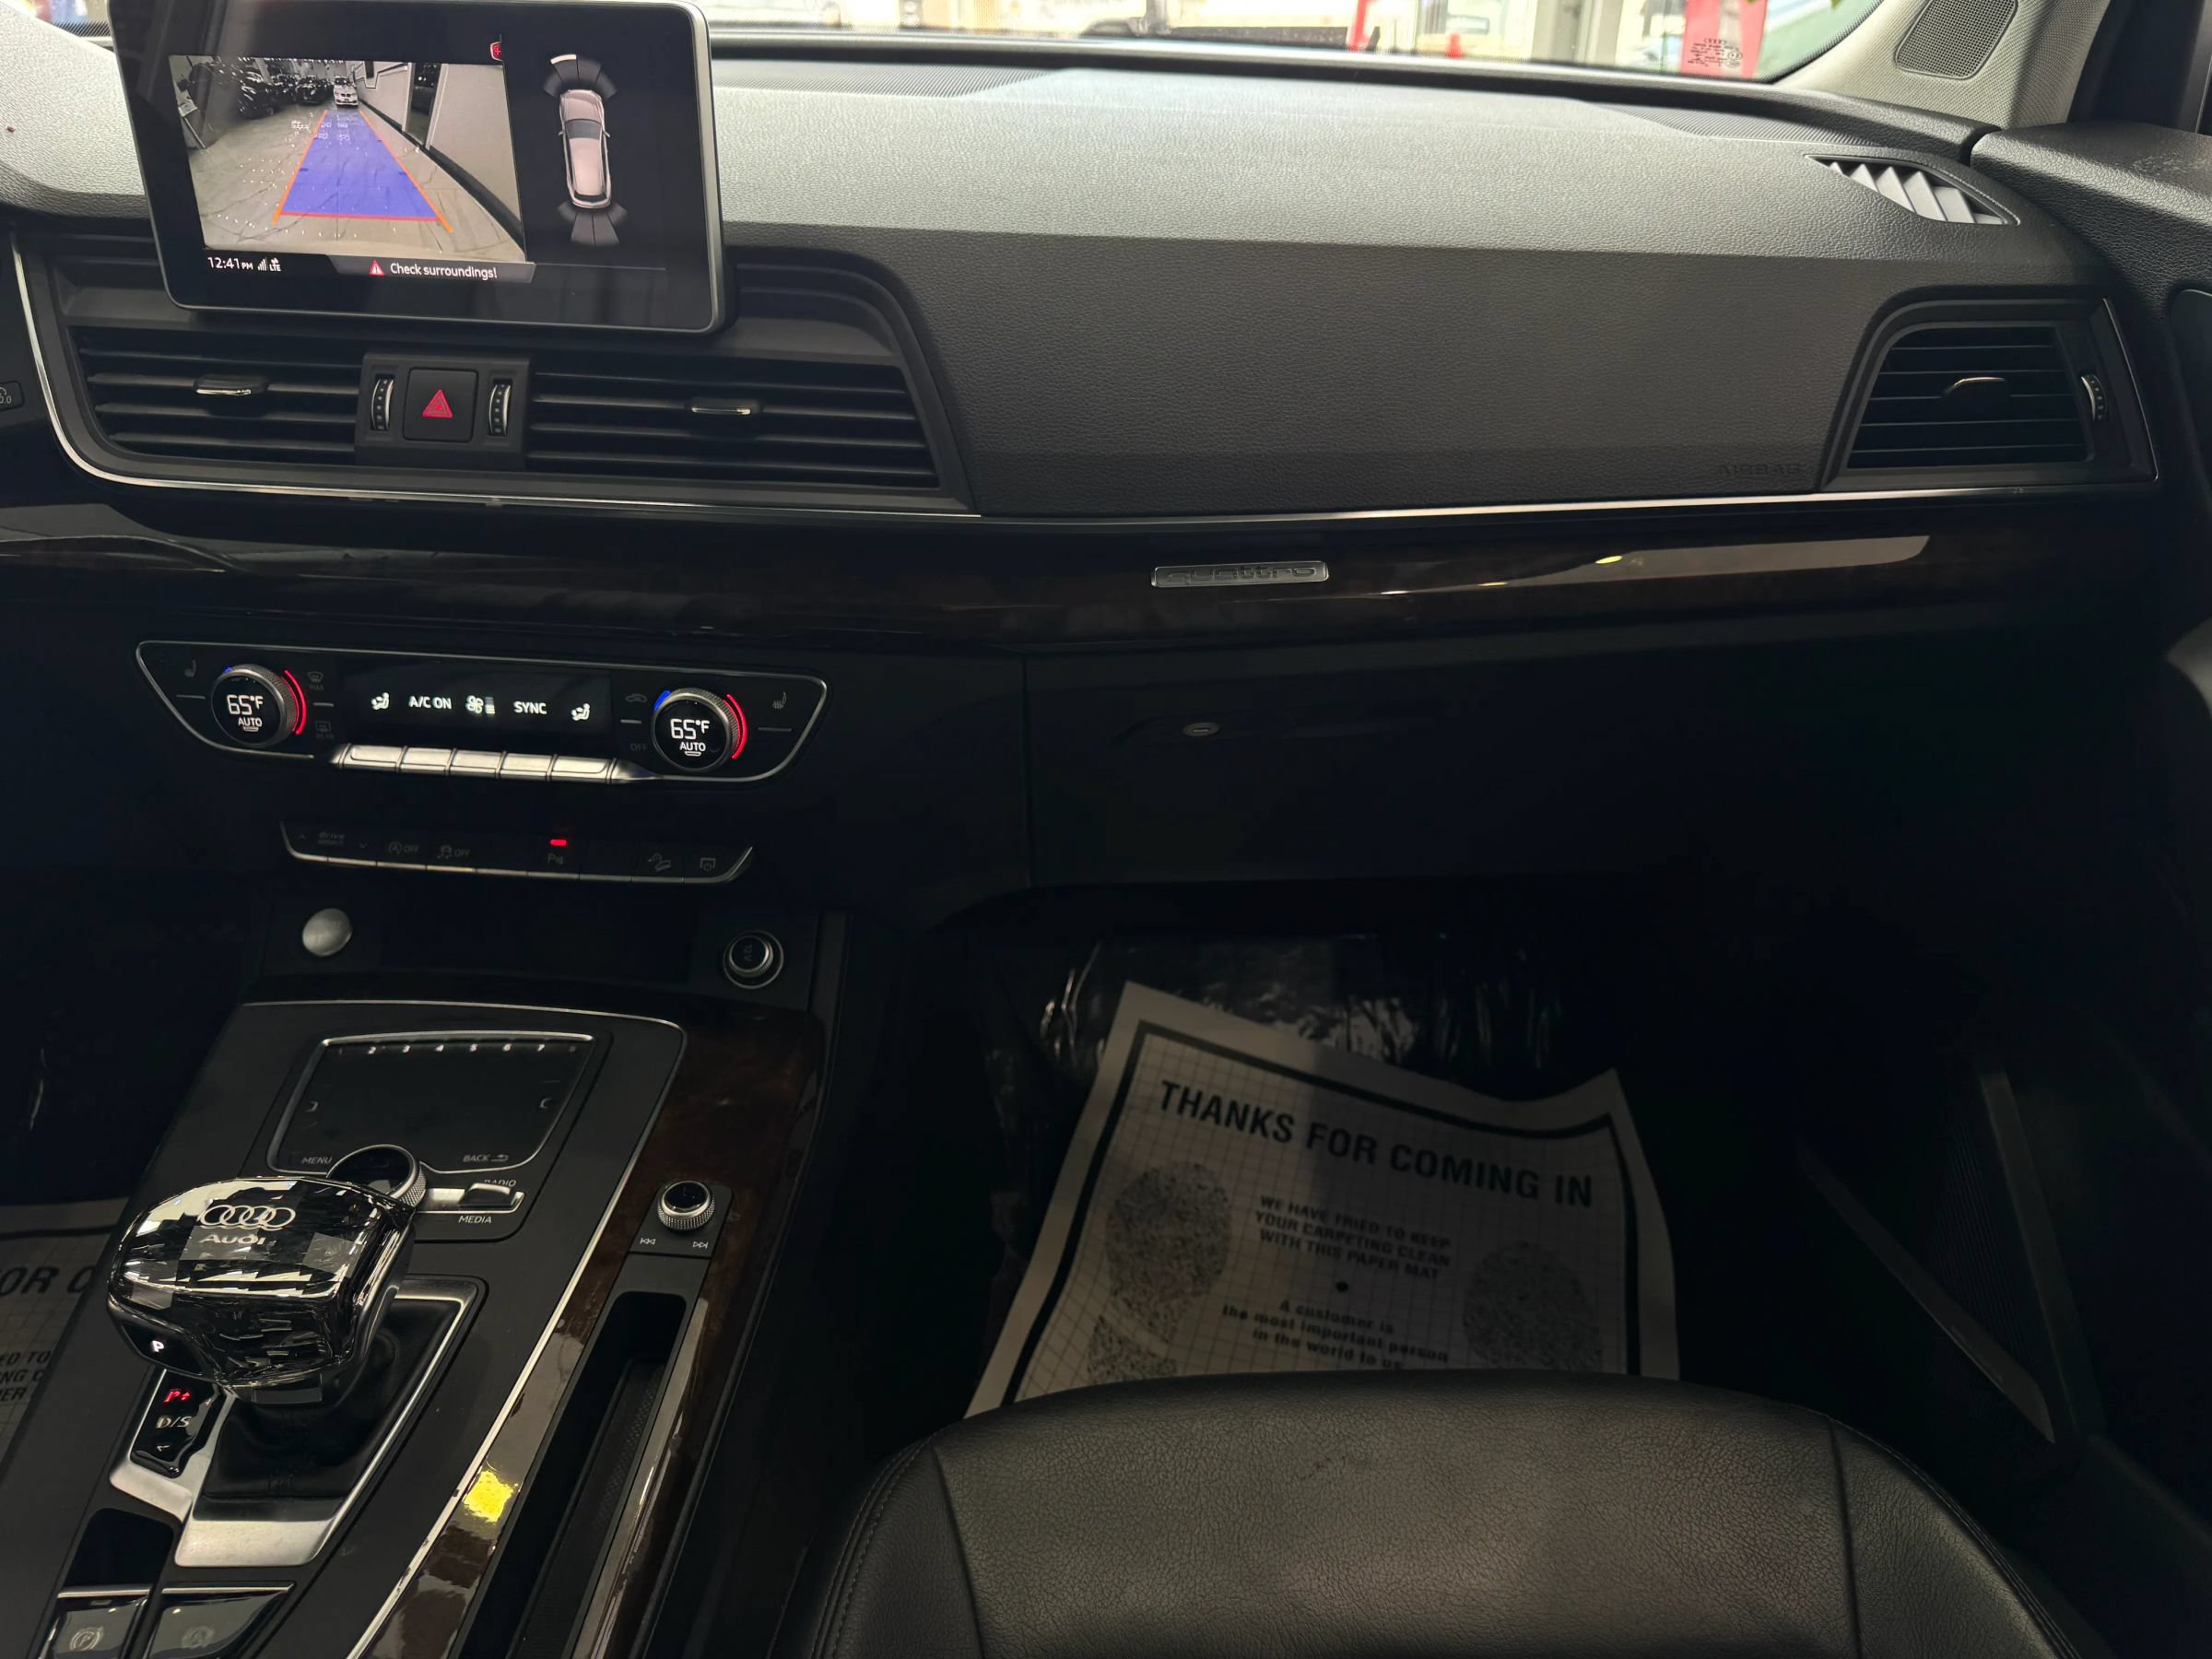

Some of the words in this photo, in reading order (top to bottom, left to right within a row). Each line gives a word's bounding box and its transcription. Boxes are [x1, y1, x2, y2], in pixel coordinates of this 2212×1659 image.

[390, 263, 421, 276] Check
[423, 265, 498, 280] surroundings!
[408, 695, 431, 709] A/C
[432, 696, 453, 710] ON
[512, 700, 547, 715] SYNC
[238, 717, 263, 727] AUTO
[679, 741, 707, 752] AUTO
[1161, 1080, 1295, 1143] THANKS
[1306, 1123, 1378, 1164] FOR
[1391, 1144, 1539, 1200] COMING
[1555, 1174, 1593, 1207] IN
[301, 1156, 333, 1165] MENU
[463, 1154, 489, 1163] BACK
[458, 1216, 492, 1225] MEDIA
[1260, 1195, 1281, 1211] WE
[1288, 1201, 1327, 1223] HAVE
[1335, 1213, 1380, 1233] TRIED
[1386, 1225, 1406, 1241] TO
[1410, 1232, 1451, 1248] KEEP
[1255, 1211, 1299, 1232] YOUR
[1302, 1225, 1393, 1254] CARPETING
[1397, 1245, 1450, 1267] CLEAN
[1260, 1230, 1301, 1250] WITH
[1307, 1240, 1342, 1260] THIS
[1347, 1250, 1400, 1272] PAPER
[1404, 1263, 1440, 1279] MAT
[1279, 1300, 1290, 1312] A
[1295, 1305, 1375, 1330] customer
[1379, 1321, 1394, 1335] is
[1222, 1304, 1248, 1320] the
[1254, 1312, 1295, 1329] most
[1300, 1320, 1383, 1349] important
[1388, 1341, 1449, 1363] person
[1253, 1329, 1268, 1341] in
[1275, 1333, 1300, 1347] the
[1306, 1339, 1355, 1361] world
[1359, 1352, 1377, 1366] to
[155, 1416, 193, 1429] D/S
